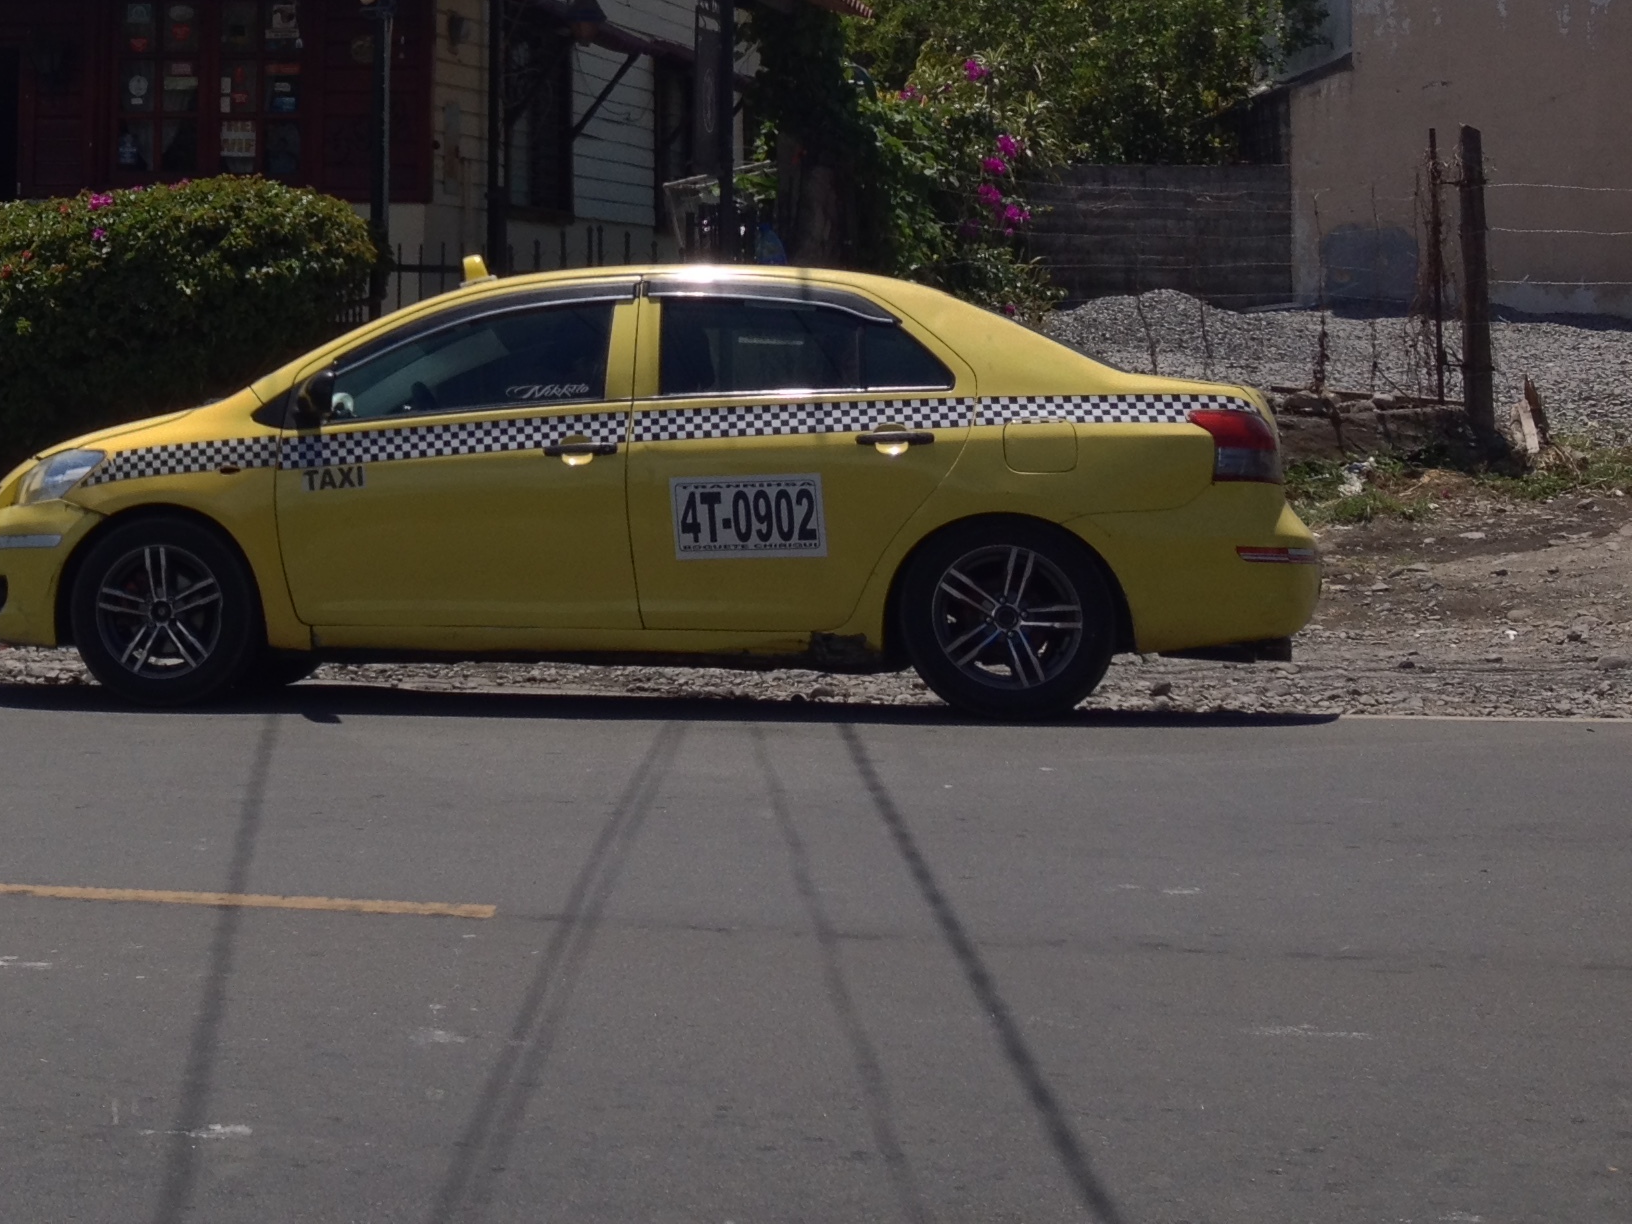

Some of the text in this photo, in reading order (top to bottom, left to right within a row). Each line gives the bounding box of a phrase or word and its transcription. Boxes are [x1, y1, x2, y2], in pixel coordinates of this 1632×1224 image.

[303, 465, 364, 491] TAXI
[680, 488, 818, 543] 4T-0902
[682, 541, 818, 551] BOQUETE CHIRIQUI
